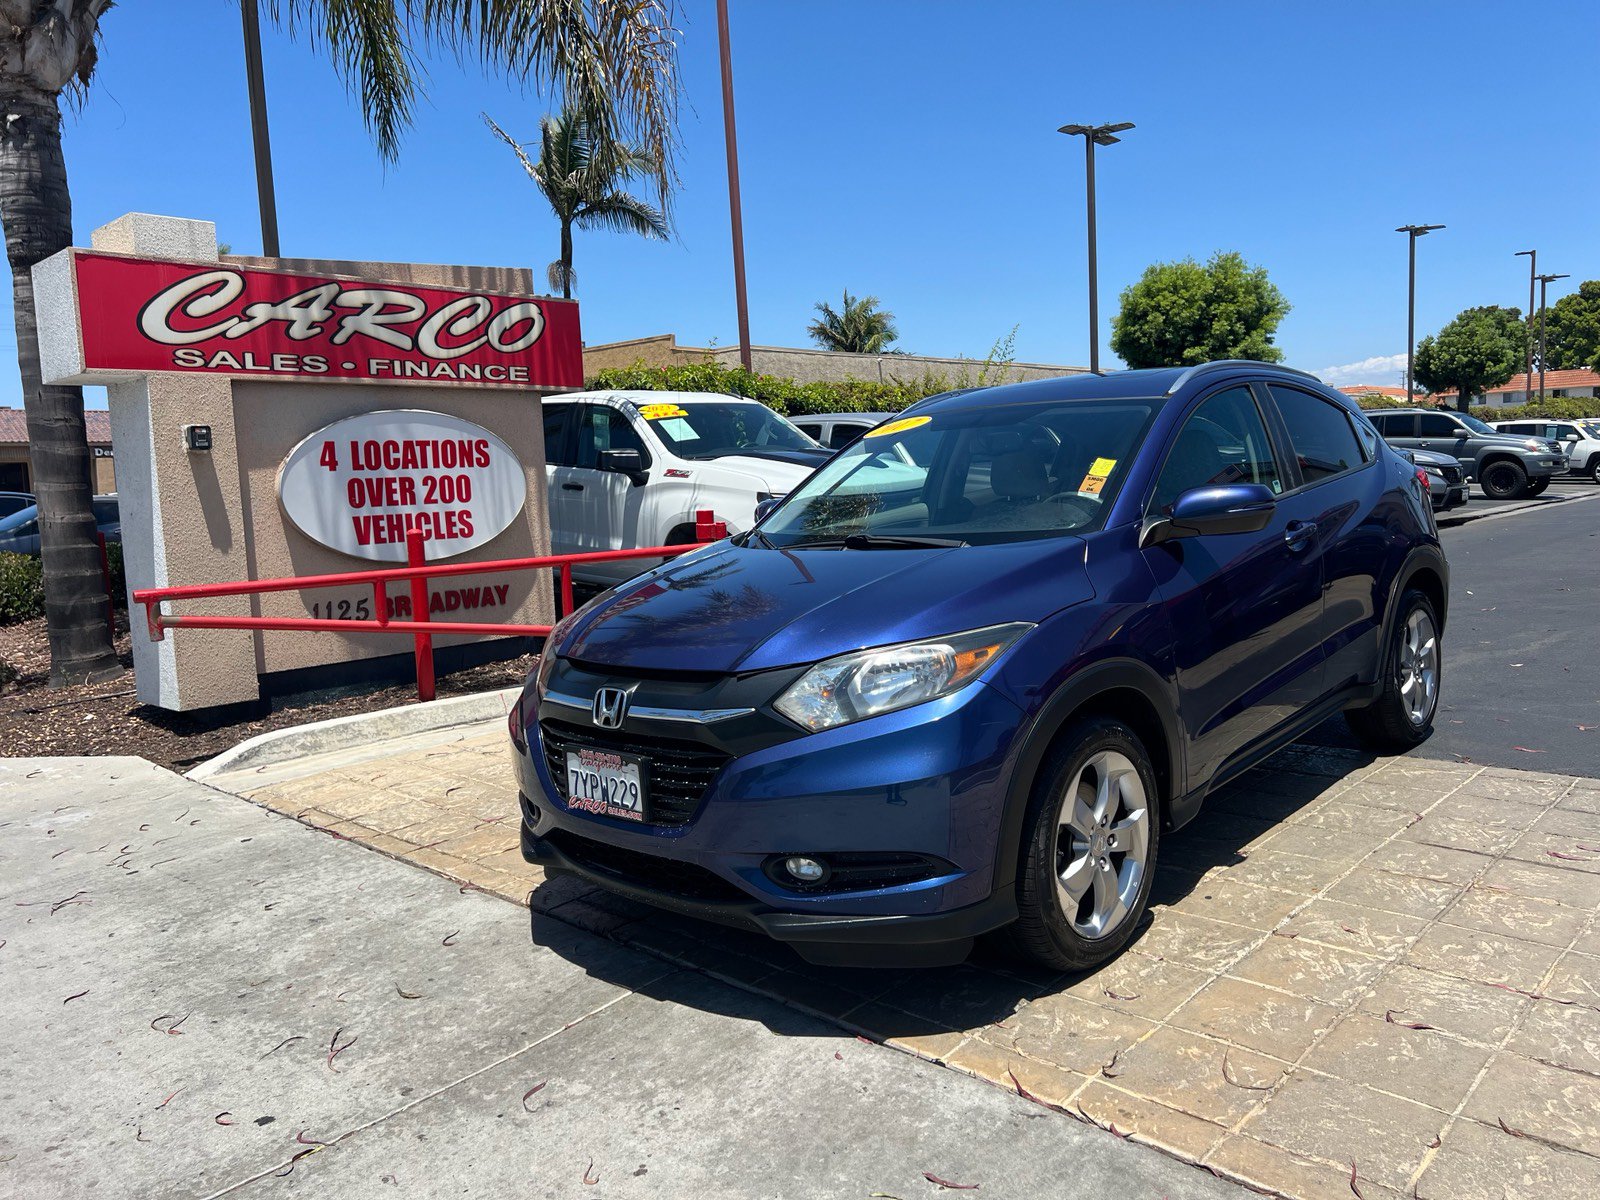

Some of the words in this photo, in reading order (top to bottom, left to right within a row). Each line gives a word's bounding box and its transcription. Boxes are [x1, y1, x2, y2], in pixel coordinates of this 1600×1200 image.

[137, 269, 546, 360] CARCO
[173, 347, 329, 374] SALES
[368, 357, 531, 383] FINANCE
[320, 440, 338, 472] 4
[350, 439, 490, 471] LOCATIONS
[347, 476, 416, 509] OVER
[422, 474, 472, 504] 200
[352, 509, 474, 546] VEHICLES
[385, 584, 510, 619] BRADWAY
[570, 767, 639, 810] 7YPW229
